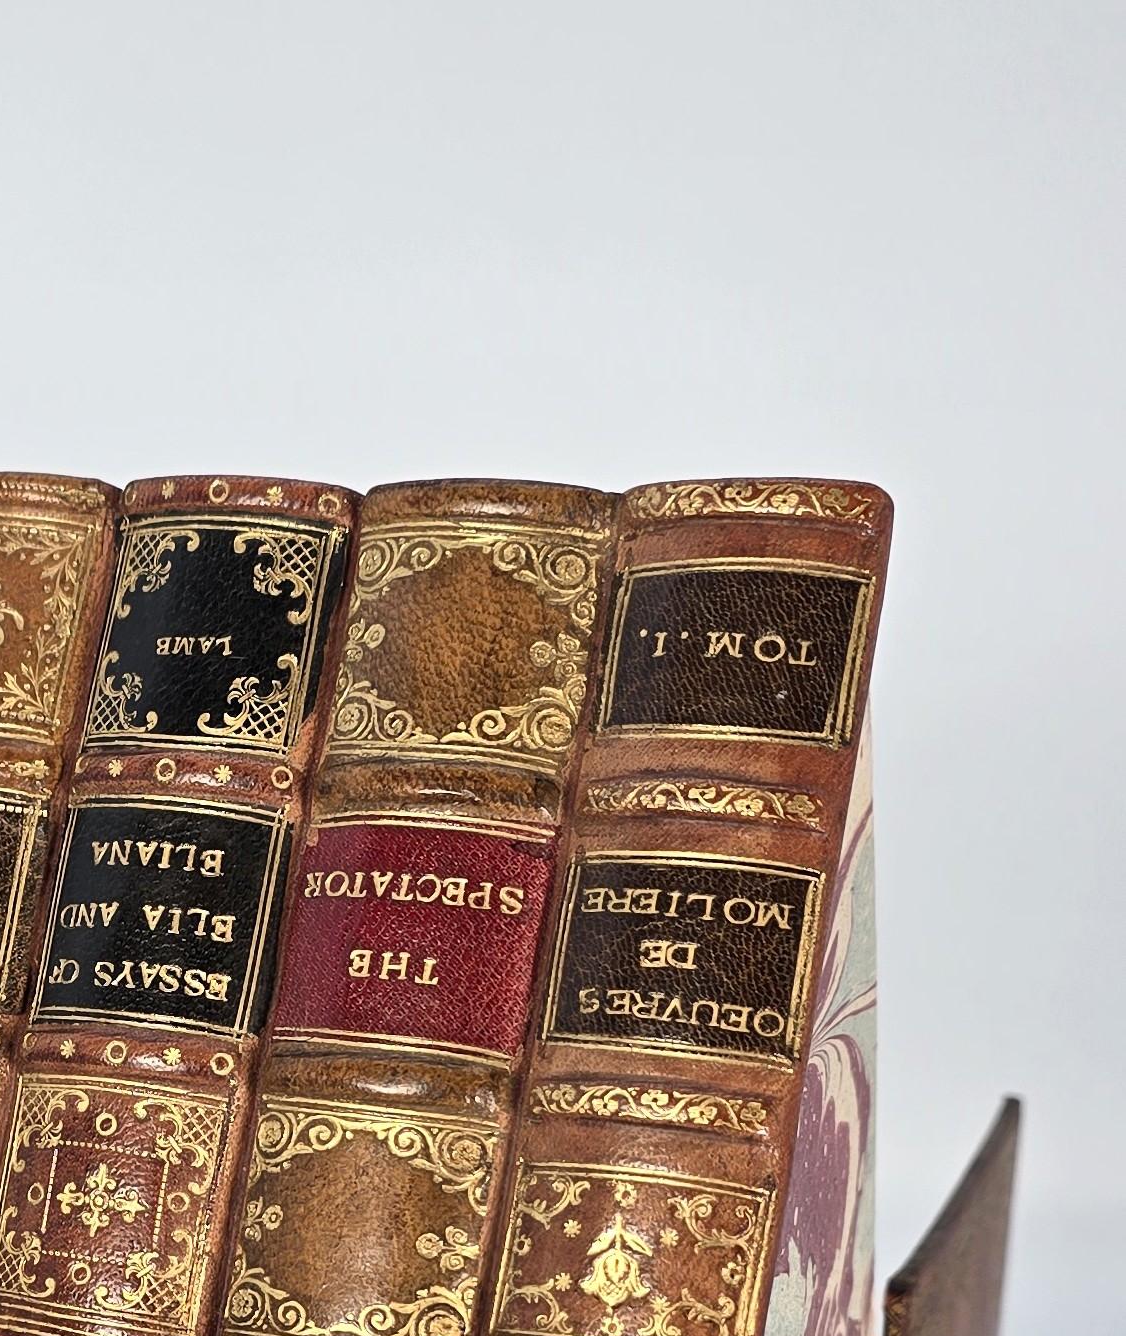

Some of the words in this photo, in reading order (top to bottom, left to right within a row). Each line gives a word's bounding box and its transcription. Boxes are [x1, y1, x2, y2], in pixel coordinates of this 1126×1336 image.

[156, 636, 232, 656] LAMB
[92, 840, 225, 878] ELIANA
[304, 870, 524, 915] SPECTATOR
[582, 887, 794, 929] MOLIERE
[61, 902, 119, 929] AND
[142, 905, 236, 943] ELIA
[49, 958, 80, 985] OF
[348, 949, 438, 985] THE
[639, 940, 699, 969] DE
[94, 960, 232, 1002] ESSAYS
[577, 987, 785, 1037] OEUVRES
